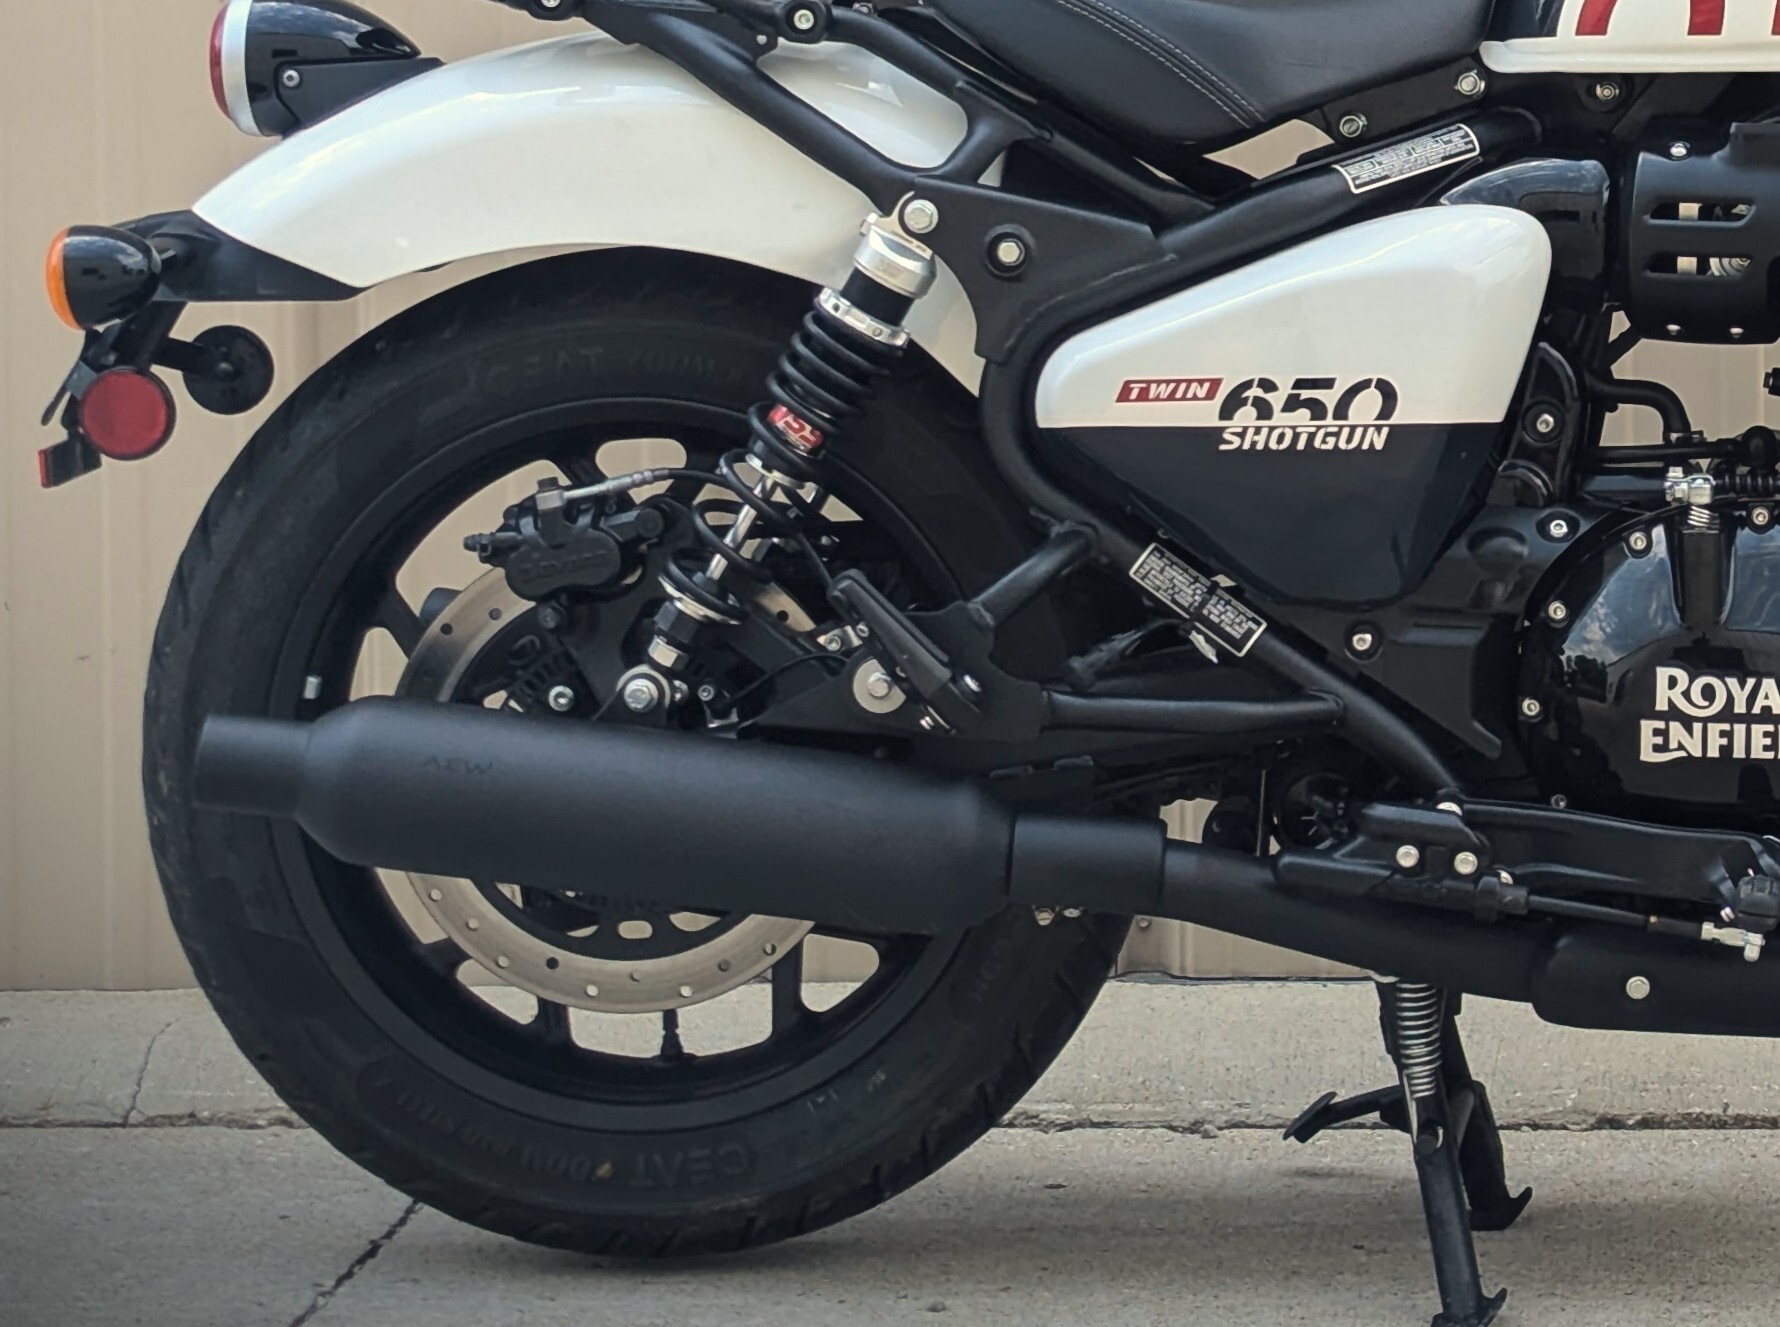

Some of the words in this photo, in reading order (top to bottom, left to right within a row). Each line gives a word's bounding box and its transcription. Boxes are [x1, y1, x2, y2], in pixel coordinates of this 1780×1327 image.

[1127, 381, 1210, 401] TWIN
[1218, 377, 1398, 421] 650
[1218, 426, 1390, 450] SHOTGUN
[632, 1147, 747, 1187] CEAT
